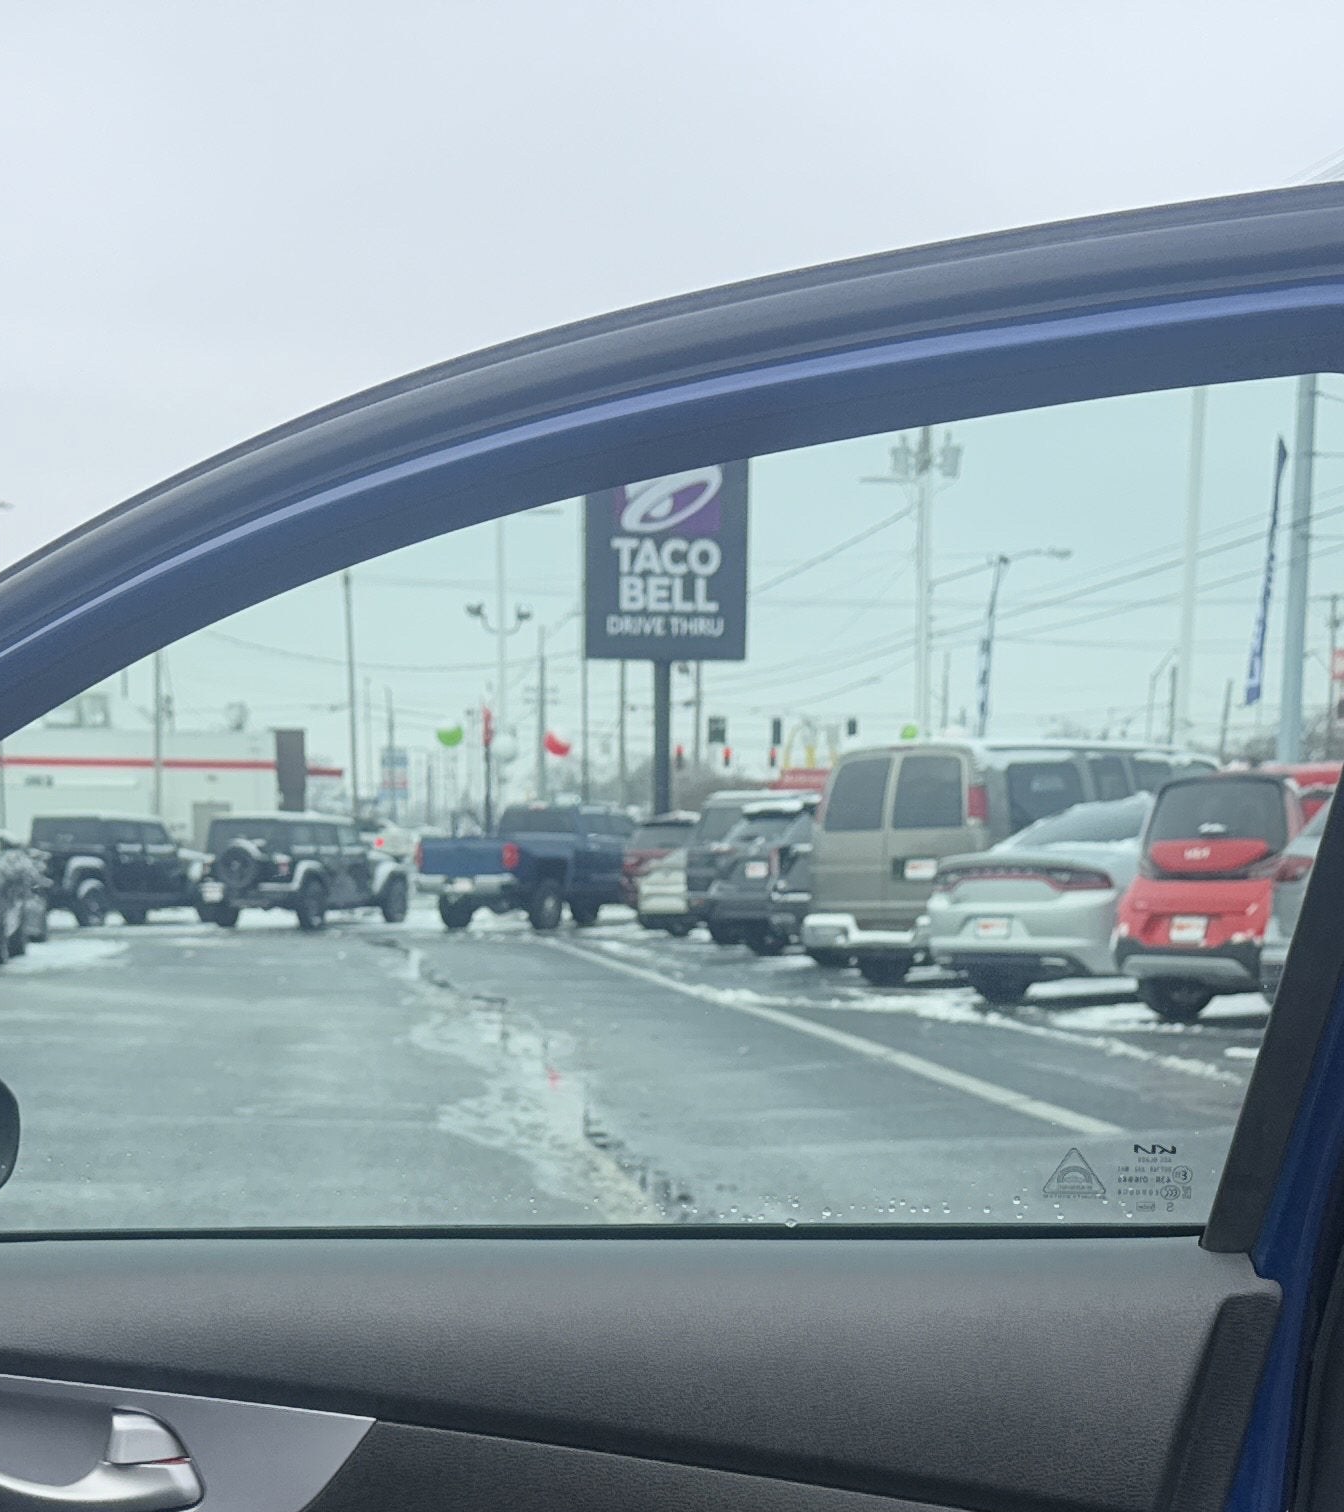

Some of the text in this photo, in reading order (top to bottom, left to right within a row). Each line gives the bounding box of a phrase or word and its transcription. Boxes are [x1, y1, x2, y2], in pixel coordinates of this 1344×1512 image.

[610, 537, 722, 577] TACO
[619, 576, 720, 612] BELL
[605, 614, 725, 638] DRIVE THRU
